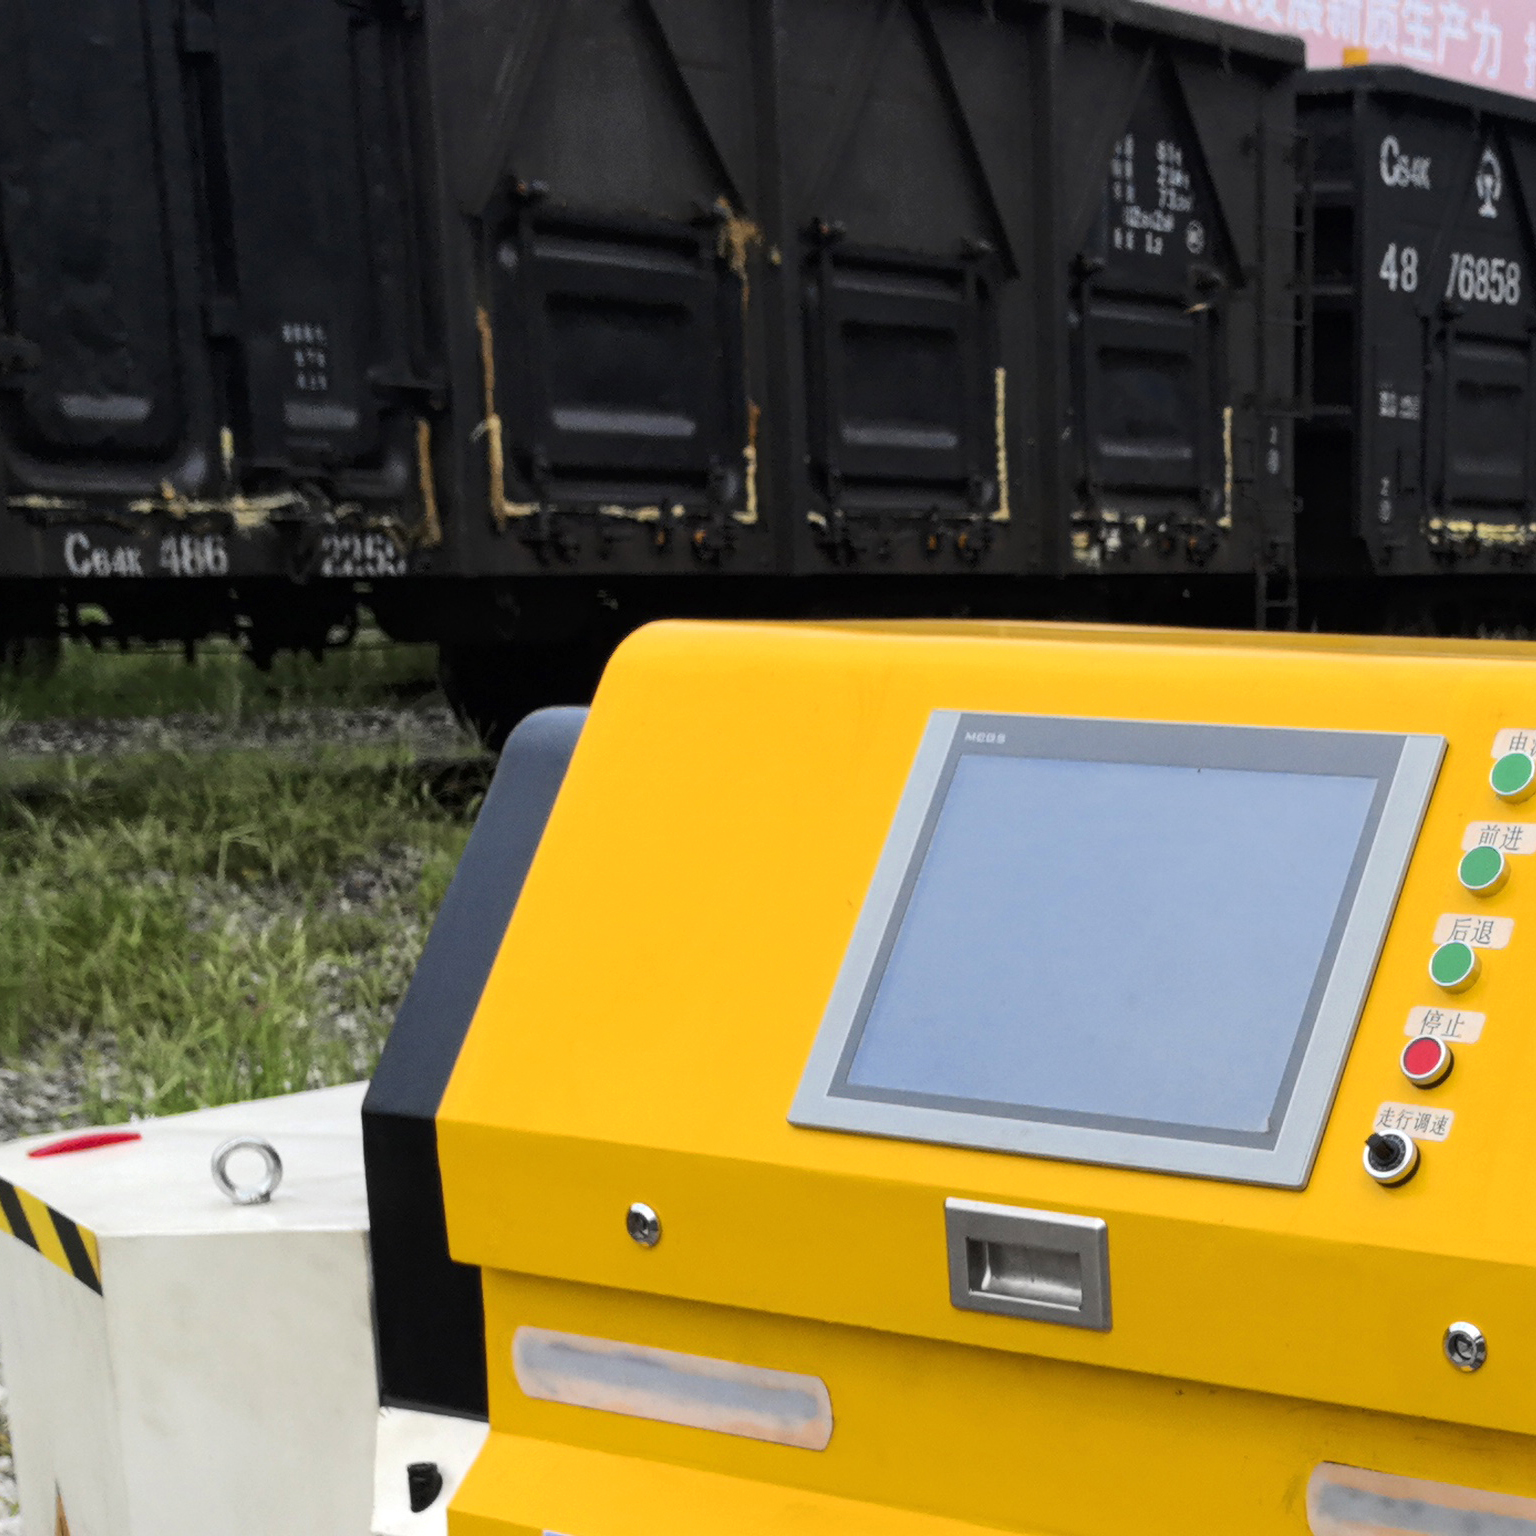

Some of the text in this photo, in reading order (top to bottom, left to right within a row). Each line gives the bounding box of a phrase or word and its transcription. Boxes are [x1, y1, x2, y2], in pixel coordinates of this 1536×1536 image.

[1379, 242, 1419, 293] 48
[159, 534, 230, 577] 486
[1478, 823, 1525, 851] 前进
[1446, 917, 1494, 945] 后退
[1420, 1008, 1466, 1038] 停止
[1375, 1106, 1450, 1136] 走行调速
